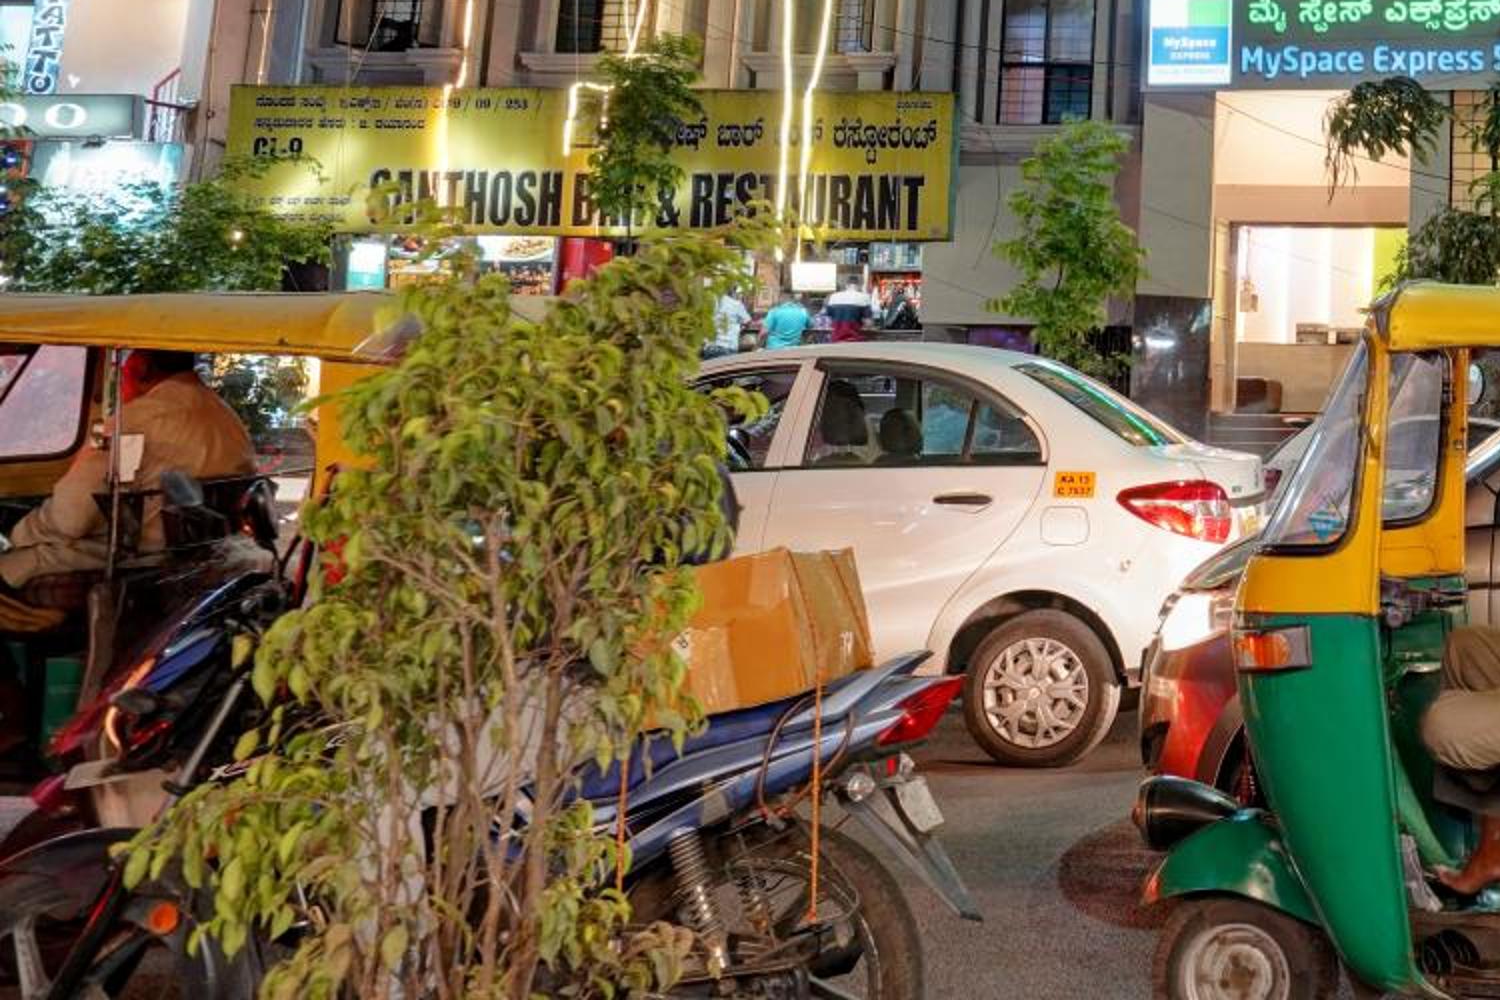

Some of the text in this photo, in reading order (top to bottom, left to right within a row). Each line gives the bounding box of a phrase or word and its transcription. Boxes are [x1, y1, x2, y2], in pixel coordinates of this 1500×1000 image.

[1241, 45, 1365, 78] MySpace
[1373, 46, 1484, 78] Express
[655, 181, 680, 228] &
